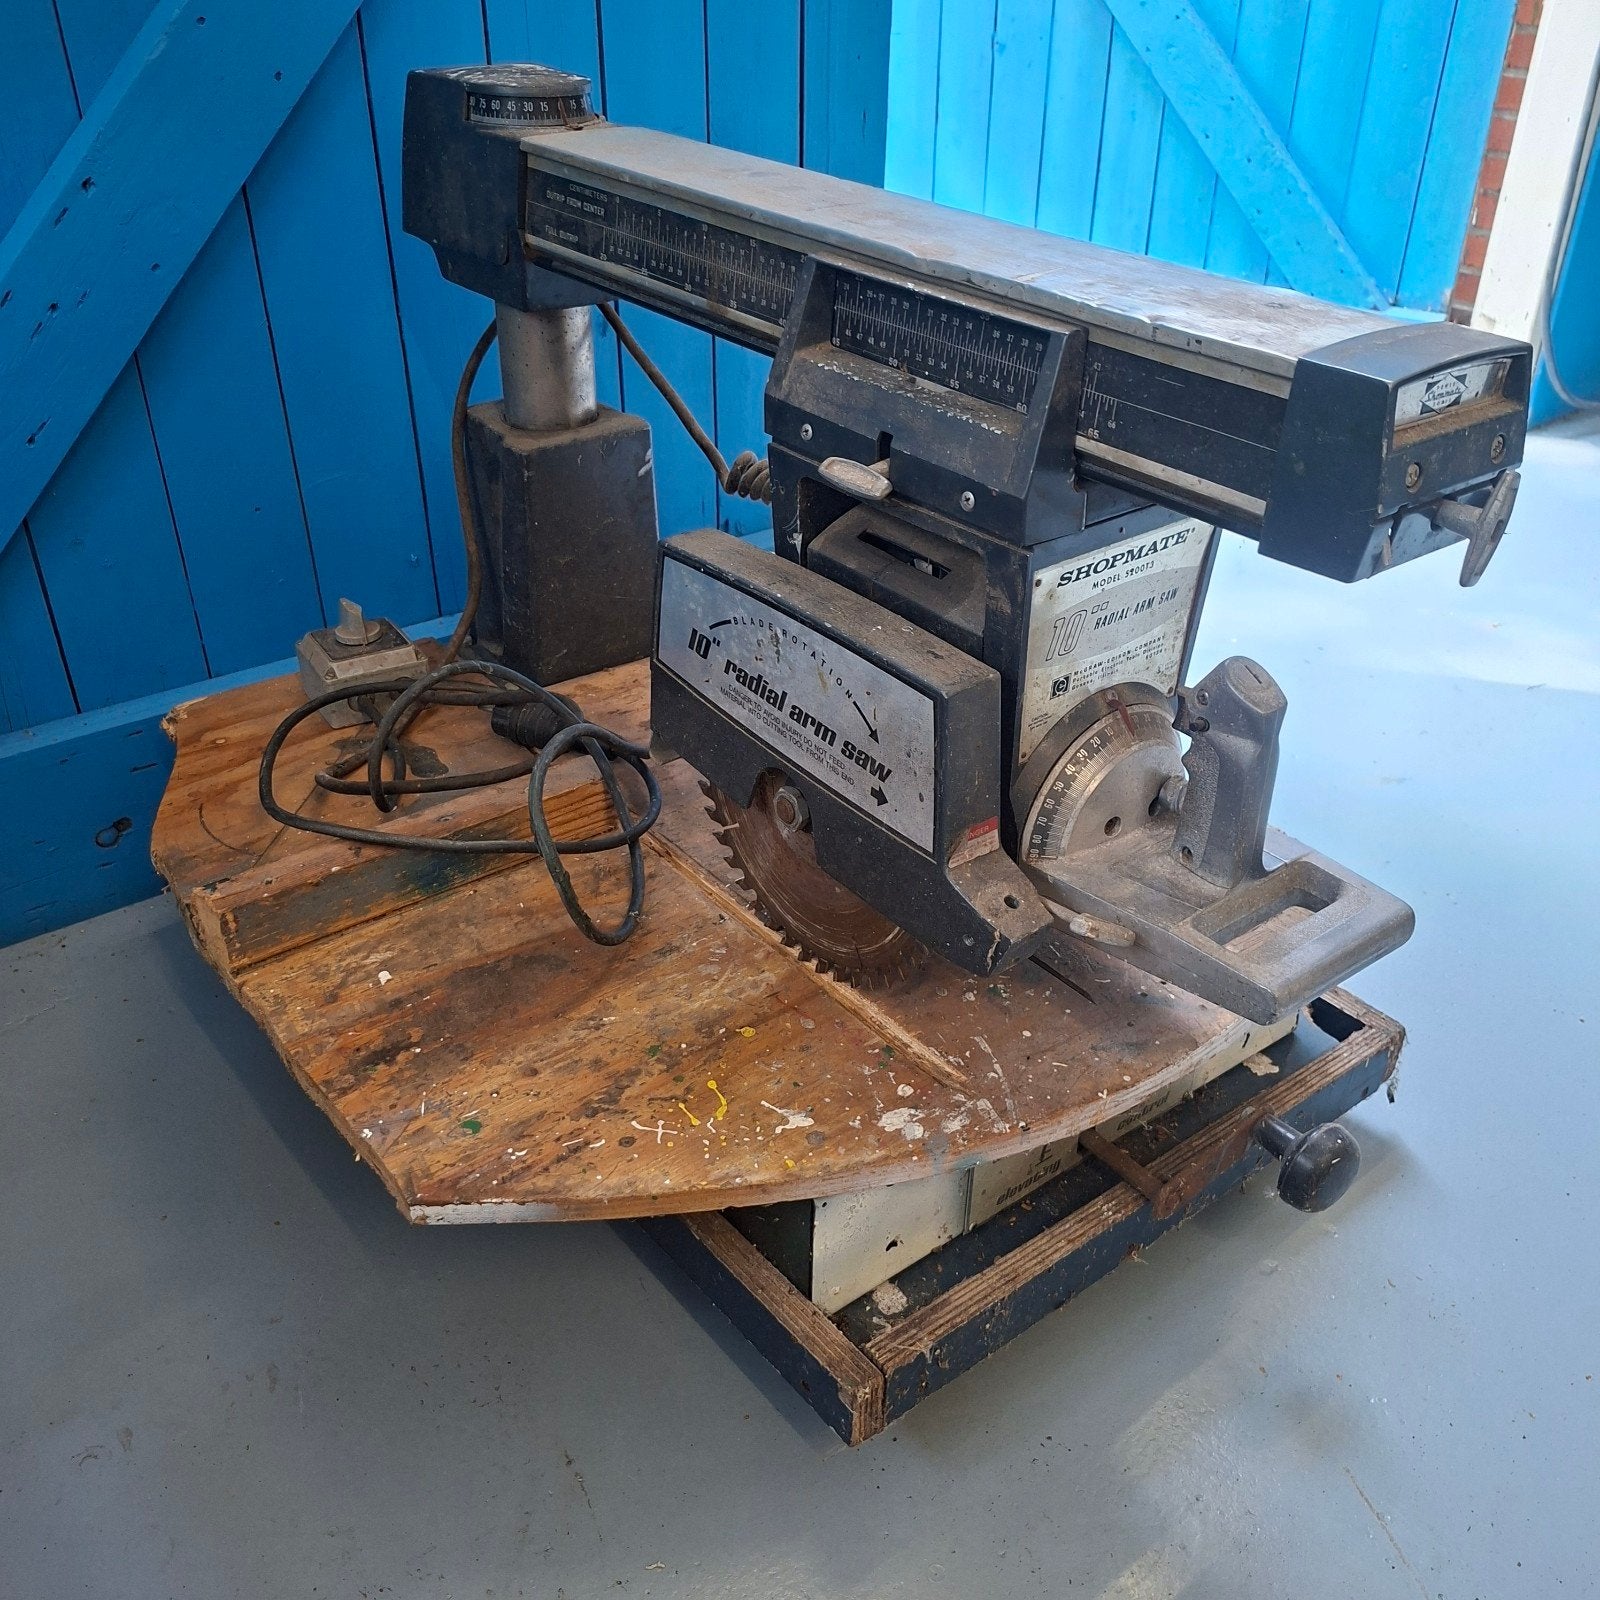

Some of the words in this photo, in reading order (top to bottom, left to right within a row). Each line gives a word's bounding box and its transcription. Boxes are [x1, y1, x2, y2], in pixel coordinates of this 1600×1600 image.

[480, 98, 487, 109] 75
[491, 100, 500, 110] 60
[507, 101, 516, 112] 45
[523, 102, 534, 112] 30
[540, 102, 549, 112] 15
[570, 100, 577, 110] 15
[583, 202, 605, 217] CENTER
[750, 239, 757, 248] 15
[1007, 334, 1014, 342] 37
[889, 357, 899, 367] 50
[950, 379, 960, 389] 55
[992, 380, 1000, 389] 58
[1017, 402, 1027, 414] 60
[1107, 420, 1117, 429] 66
[1088, 427, 1100, 439] 65
[1057, 528, 1191, 588] SHOPMATE
[1092, 573, 1121, 590] MODEL
[1094, 607, 1130, 631] RADIAL
[1132, 596, 1155, 616] ARM
[1158, 587, 1179, 606] SAW
[732, 616, 774, 632] BLADE
[1134, 635, 1166, 652] COMPANY
[782, 629, 853, 699] ROTATION
[723, 659, 788, 713] radial
[789, 704, 838, 748] arm
[841, 740, 893, 784] saw
[720, 686, 746, 710] MATERIAL
[748, 708, 762, 720] INTO
[763, 717, 788, 739] CUTTING
[789, 735, 805, 751] TOOL
[806, 747, 825, 765] FROM
[826, 761, 839, 776] THIS
[754, 702, 762, 712] TO
[763, 709, 781, 725] AVOID
[804, 736, 813, 748] DO
[814, 744, 827, 759] NOT
[829, 754, 846, 770] FEED
[1104, 726, 1114, 737] 10
[1090, 736, 1101, 748] 20
[1064, 764, 1076, 776] 40
[1053, 781, 1065, 792] 50
[1044, 798, 1055, 809] 60
[1037, 816, 1048, 827] 70
[1032, 834, 1042, 844] 80
[1030, 849, 1040, 859] 90
